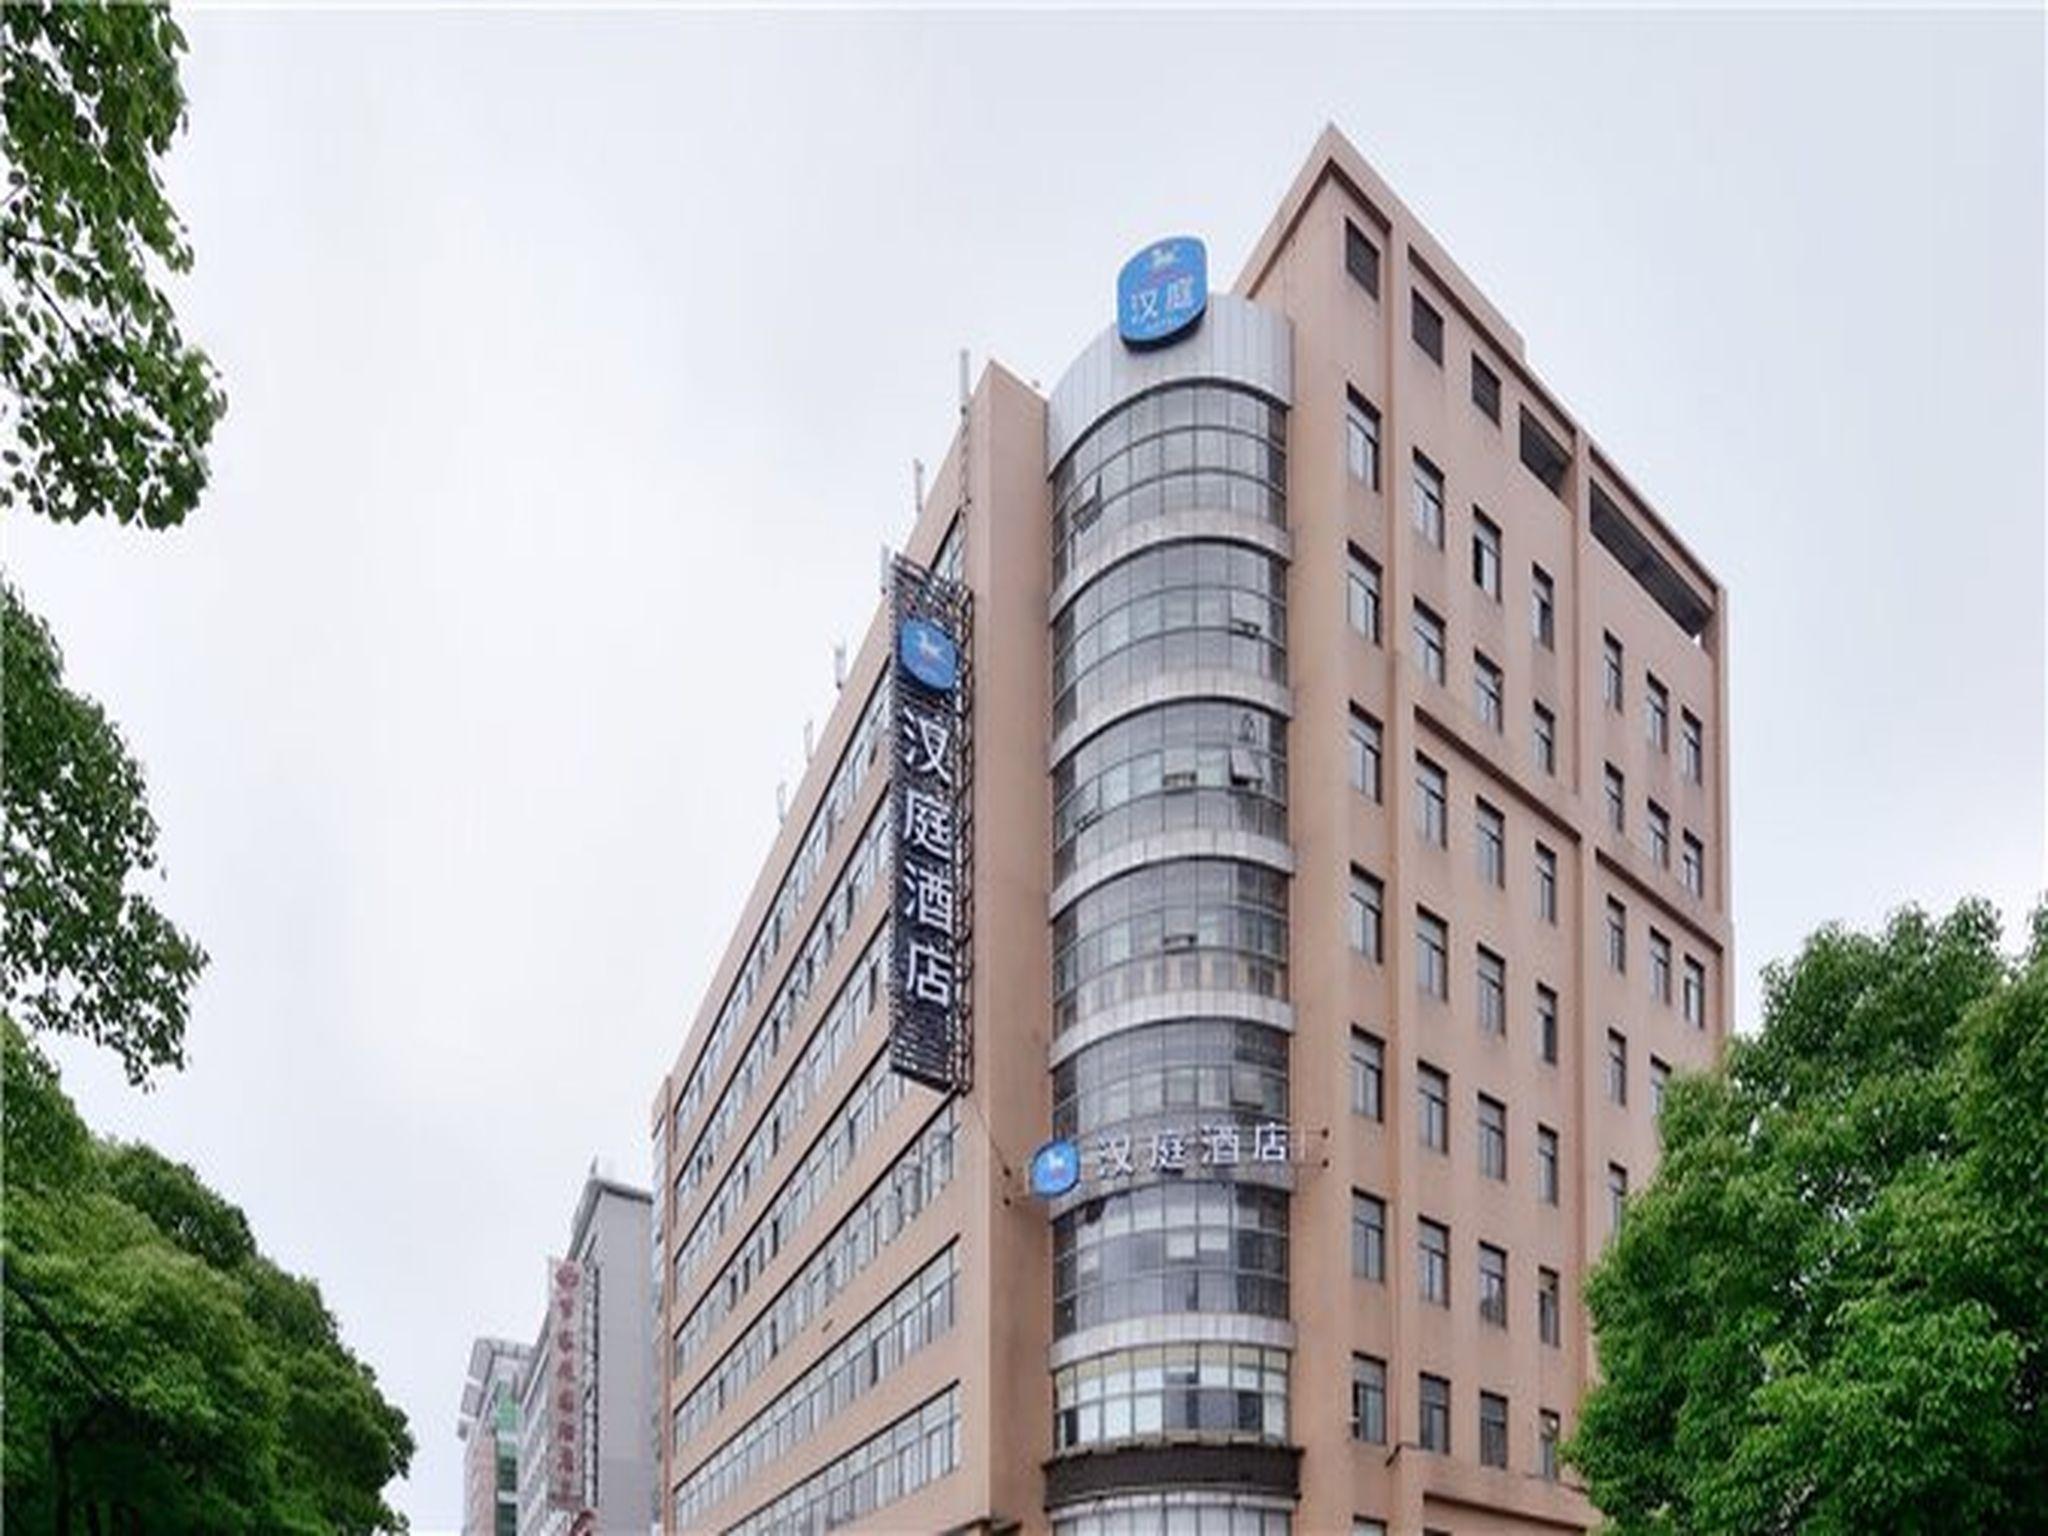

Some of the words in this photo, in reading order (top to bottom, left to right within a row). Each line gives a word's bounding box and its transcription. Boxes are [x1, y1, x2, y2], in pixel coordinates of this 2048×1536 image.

[1130, 275, 1196, 325] 汉庭
[902, 707, 953, 1009] 汉庭酒店
[1098, 1122, 1289, 1178] 汉庭酒店
